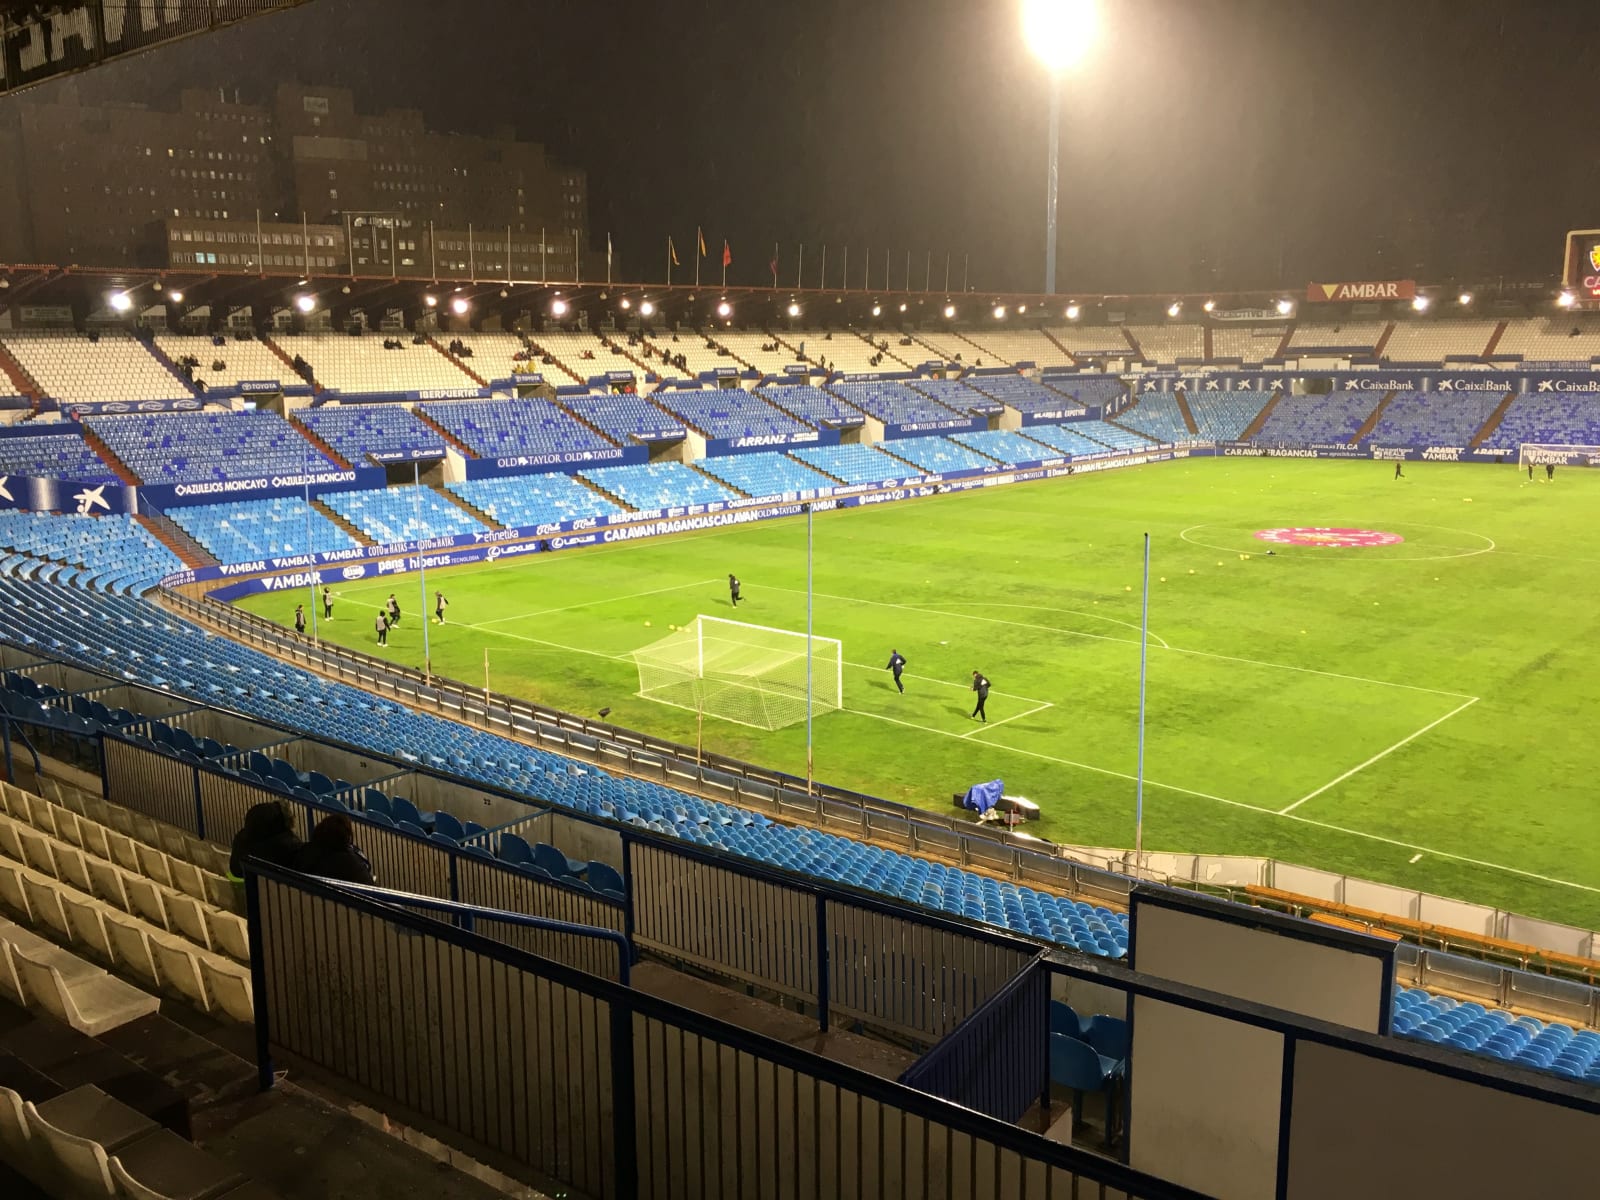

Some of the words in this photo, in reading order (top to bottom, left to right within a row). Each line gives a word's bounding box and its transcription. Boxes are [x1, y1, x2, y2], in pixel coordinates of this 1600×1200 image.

[1339, 283, 1399, 299] AMBAR
[1360, 379, 1415, 391] CaixaBank
[1454, 379, 1512, 391] CaixaBank
[419, 389, 479, 399] IBERPUERTAS
[900, 423, 912, 432] OLD
[918, 422, 937, 431] TAYLOR
[938, 420, 949, 429] OLD
[954, 418, 972, 427] TAYLOR
[737, 434, 786, 447] ARRANZ
[564, 452, 583, 463] OLD
[592, 449, 624, 460] TAYLOR
[1224, 448, 1264, 456] CARAVAN
[1267, 449, 1318, 458] FRAGANCIAS
[1428, 453, 1459, 461] AMBAR
[498, 457, 518, 468] OLD
[528, 454, 561, 465] TAYLOR
[1534, 456, 1568, 465] AMBAR
[185, 482, 223, 494] AZULEJOS
[225, 479, 268, 491] MONCAYO
[280, 475, 315, 487] AZULEJOS
[317, 472, 356, 483] MONCAYO
[757, 509, 772, 519] OLD
[778, 505, 802, 515] TAYLOR
[811, 499, 837, 512] AMBAR
[608, 509, 662, 524] IBERPUERTAS
[604, 523, 656, 542] CARAVAN
[656, 515, 715, 535] FRAGANCIAS
[714, 510, 758, 526] CARAVAN
[484, 528, 519, 542] efinetika
[368, 545, 384, 557] COTO
[389, 542, 408, 553] HAYAS
[417, 539, 432, 550] COTO
[437, 536, 455, 548] HAYAS
[501, 543, 536, 555] LEXUS
[280, 554, 316, 568] AMBAR
[330, 549, 364, 561] AMBAR
[409, 555, 451, 569] hiberus
[228, 561, 266, 575] AMBAR
[378, 559, 404, 573] pans
[273, 571, 323, 589] AMBAR
